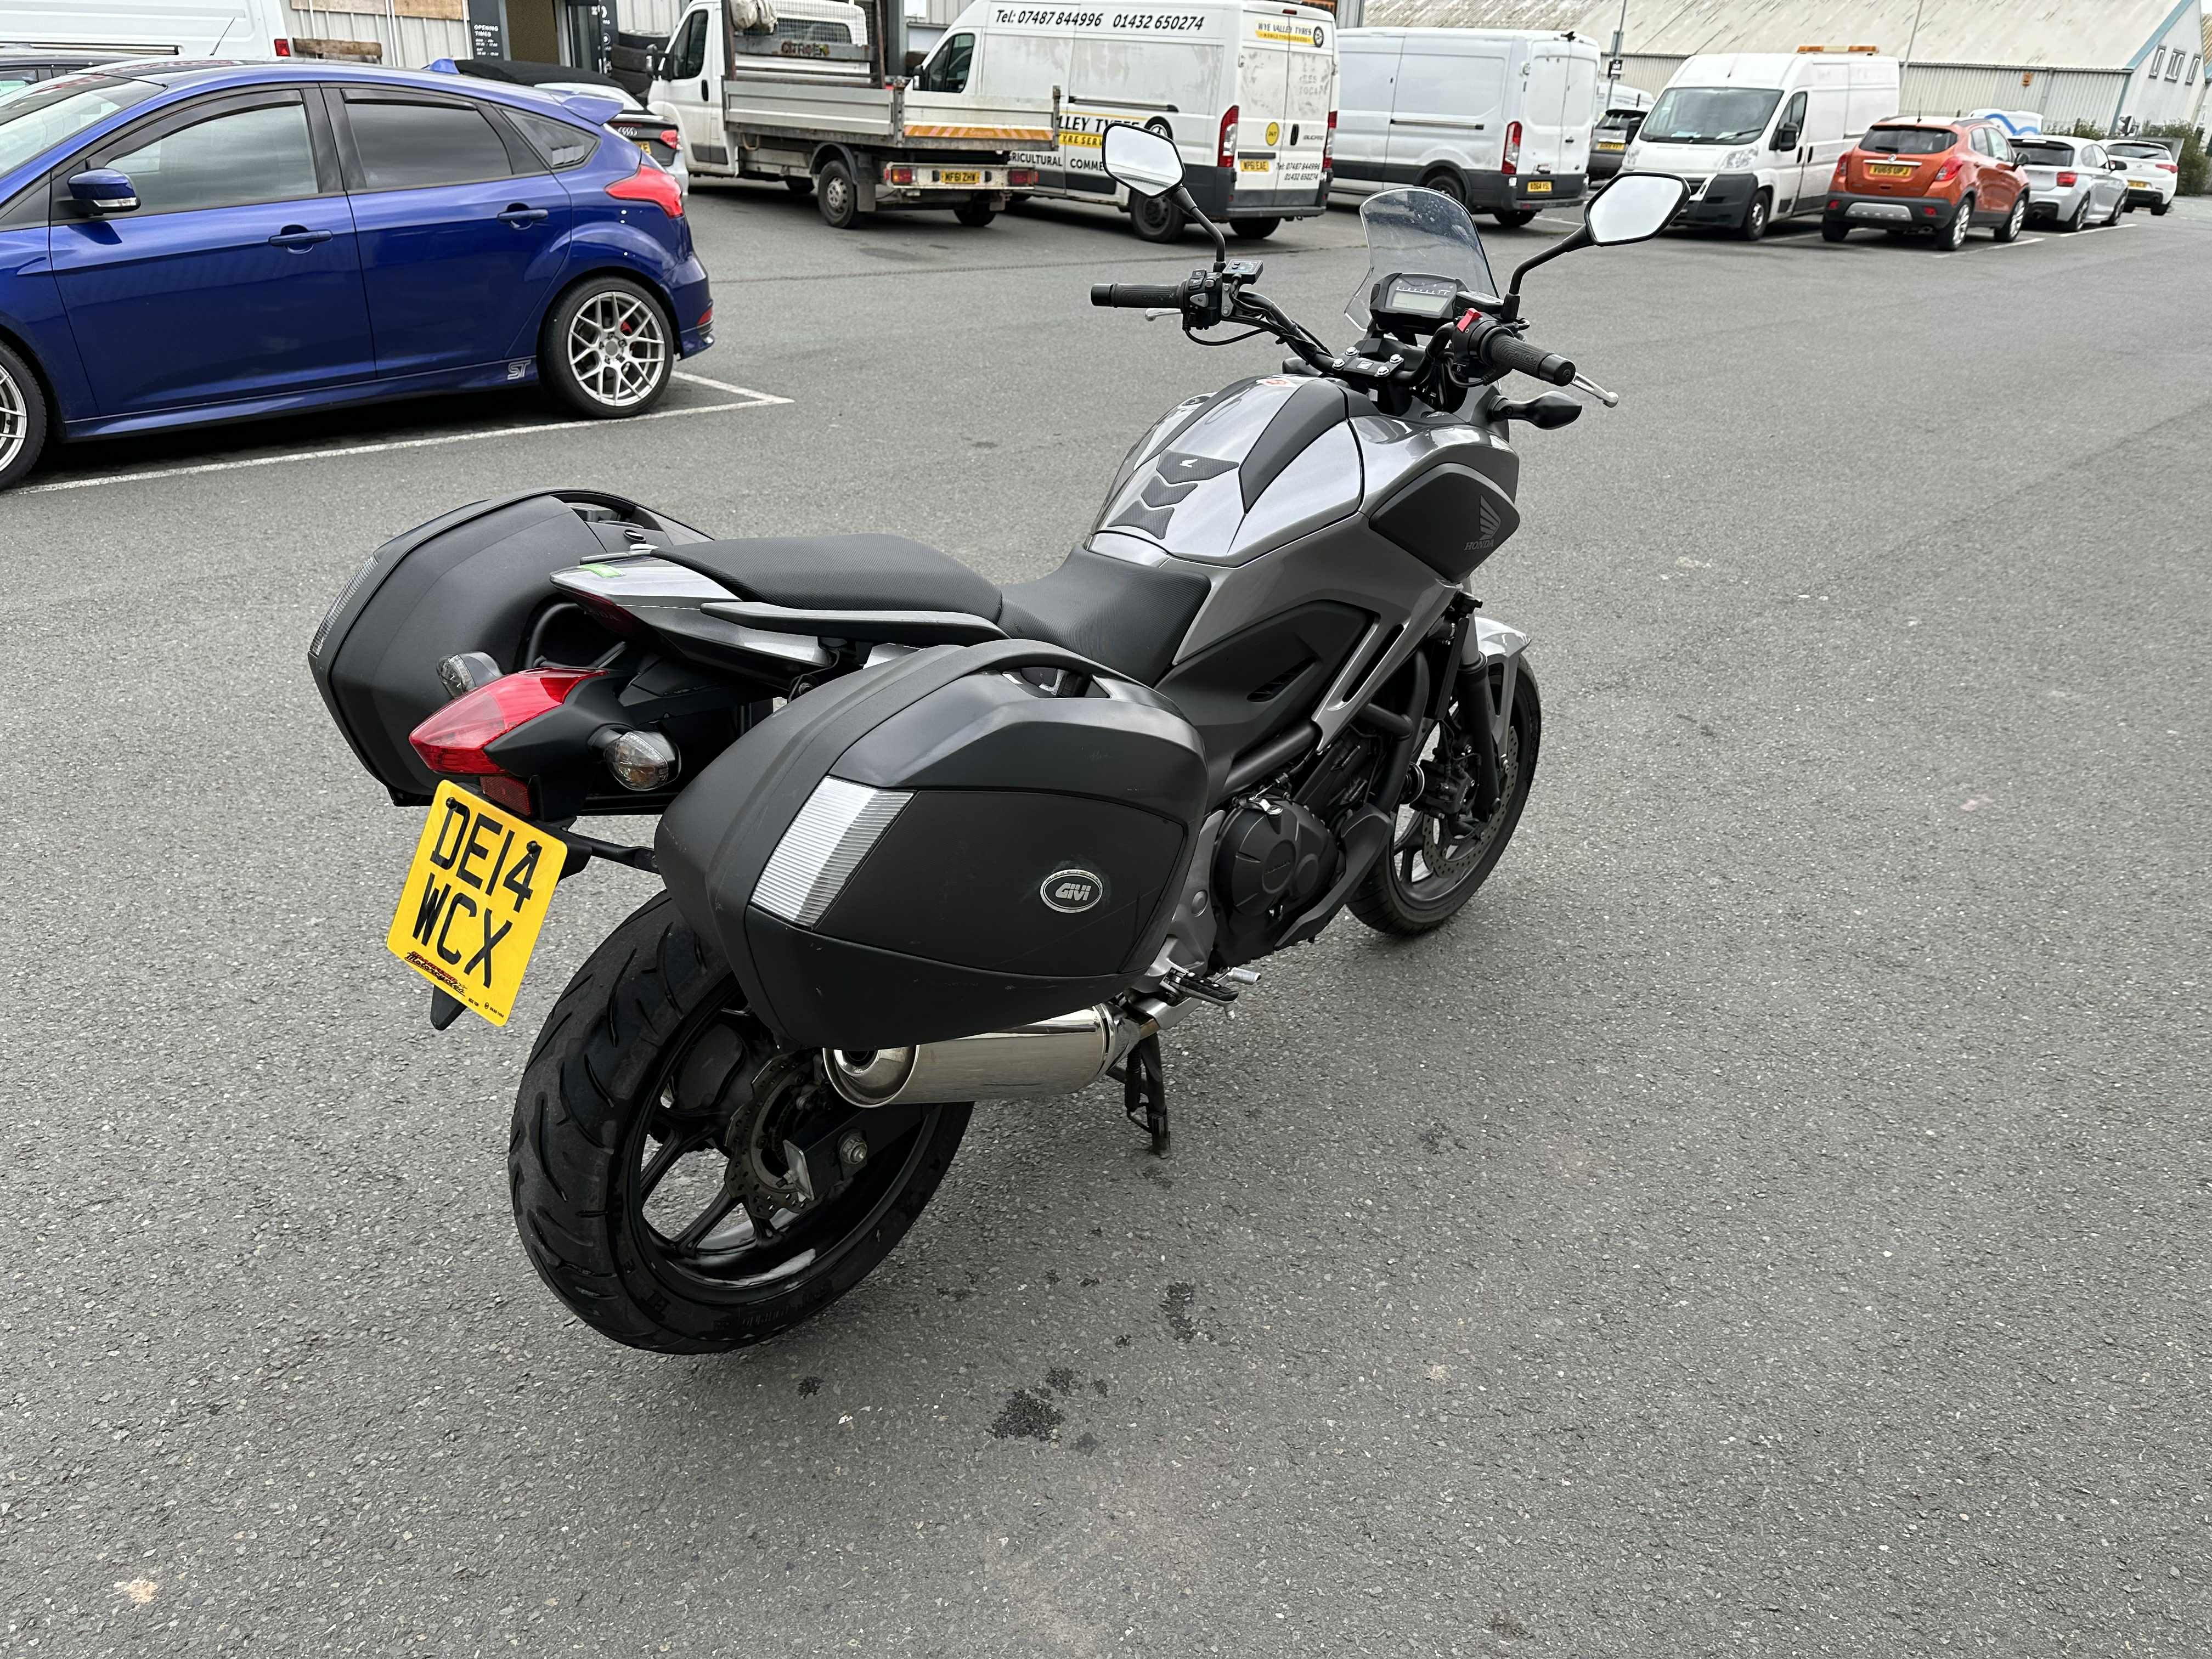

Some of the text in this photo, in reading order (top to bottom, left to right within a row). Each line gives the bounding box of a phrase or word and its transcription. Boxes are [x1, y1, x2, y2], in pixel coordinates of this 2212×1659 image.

[996, 9, 1205, 31] Tel: 07487 844996 01432 650274
[1258, 22, 1312, 36] WYE VALLEY TYRES
[1060, 134, 1078, 143] YRE
[1010, 152, 1063, 167] RICULTURAL
[507, 360, 532, 380] ST
[1464, 539, 1494, 551] HONDA
[430, 800, 543, 912] DE14
[1055, 883, 1092, 901] GIVI
[412, 872, 513, 989] WCX
[405, 952, 466, 996] Motorcycles
